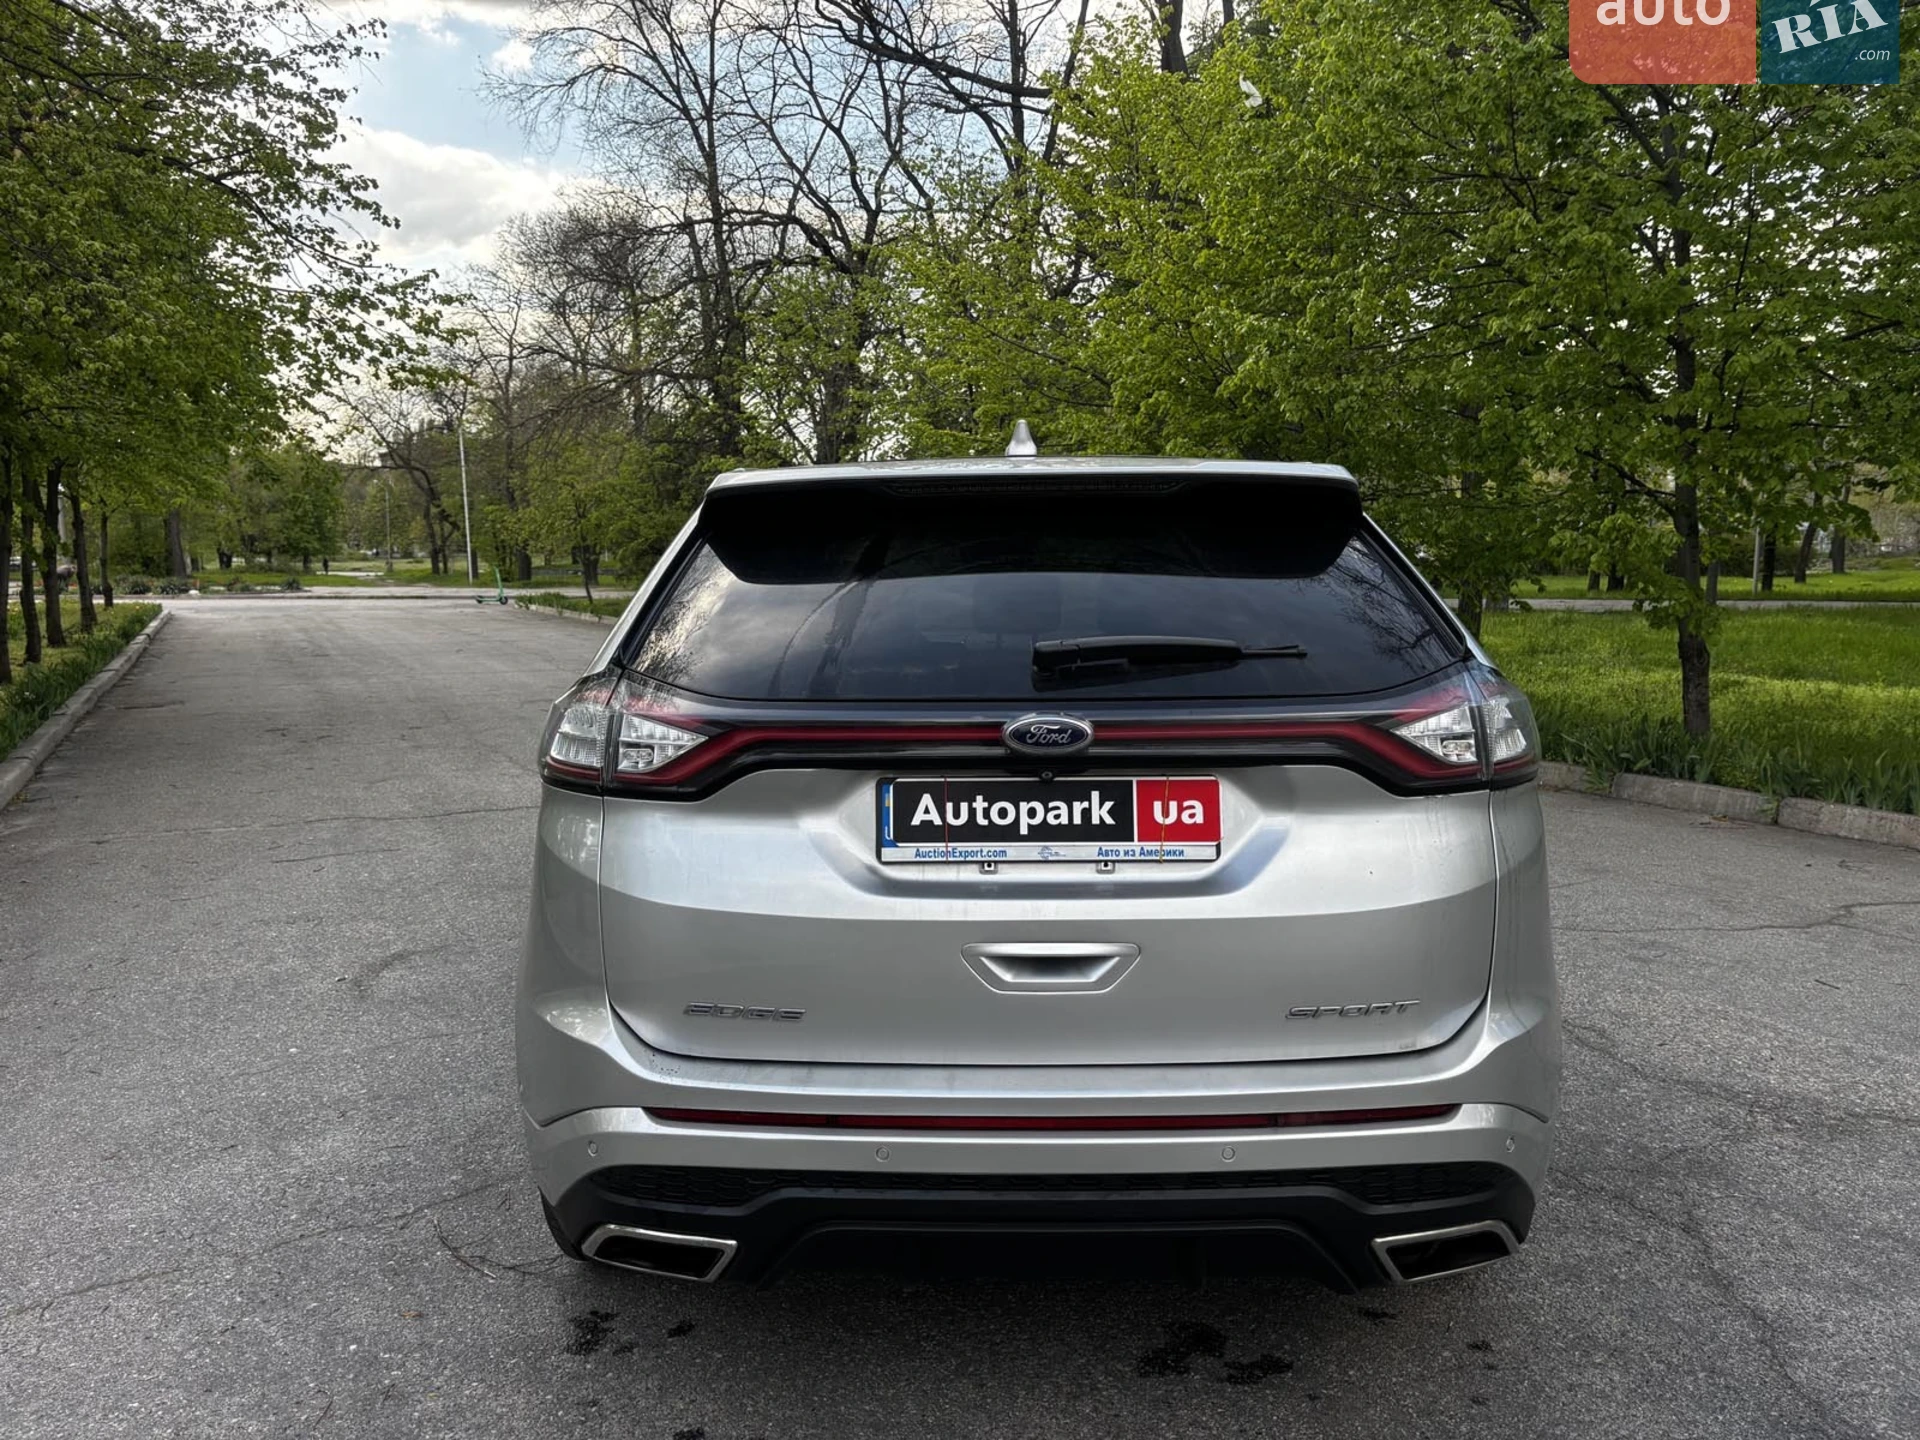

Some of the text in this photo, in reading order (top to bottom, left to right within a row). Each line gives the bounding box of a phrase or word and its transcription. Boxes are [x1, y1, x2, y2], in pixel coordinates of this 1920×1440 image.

[1025, 724, 1073, 744] Ford
[910, 790, 1116, 835] Autopark
[1152, 799, 1205, 825] ua
[914, 847, 1008, 860] AuctionExport.com
[1097, 846, 1185, 859] Авто из Америки
[683, 1002, 806, 1021] EDGE
[1285, 999, 1421, 1019] SPORT
